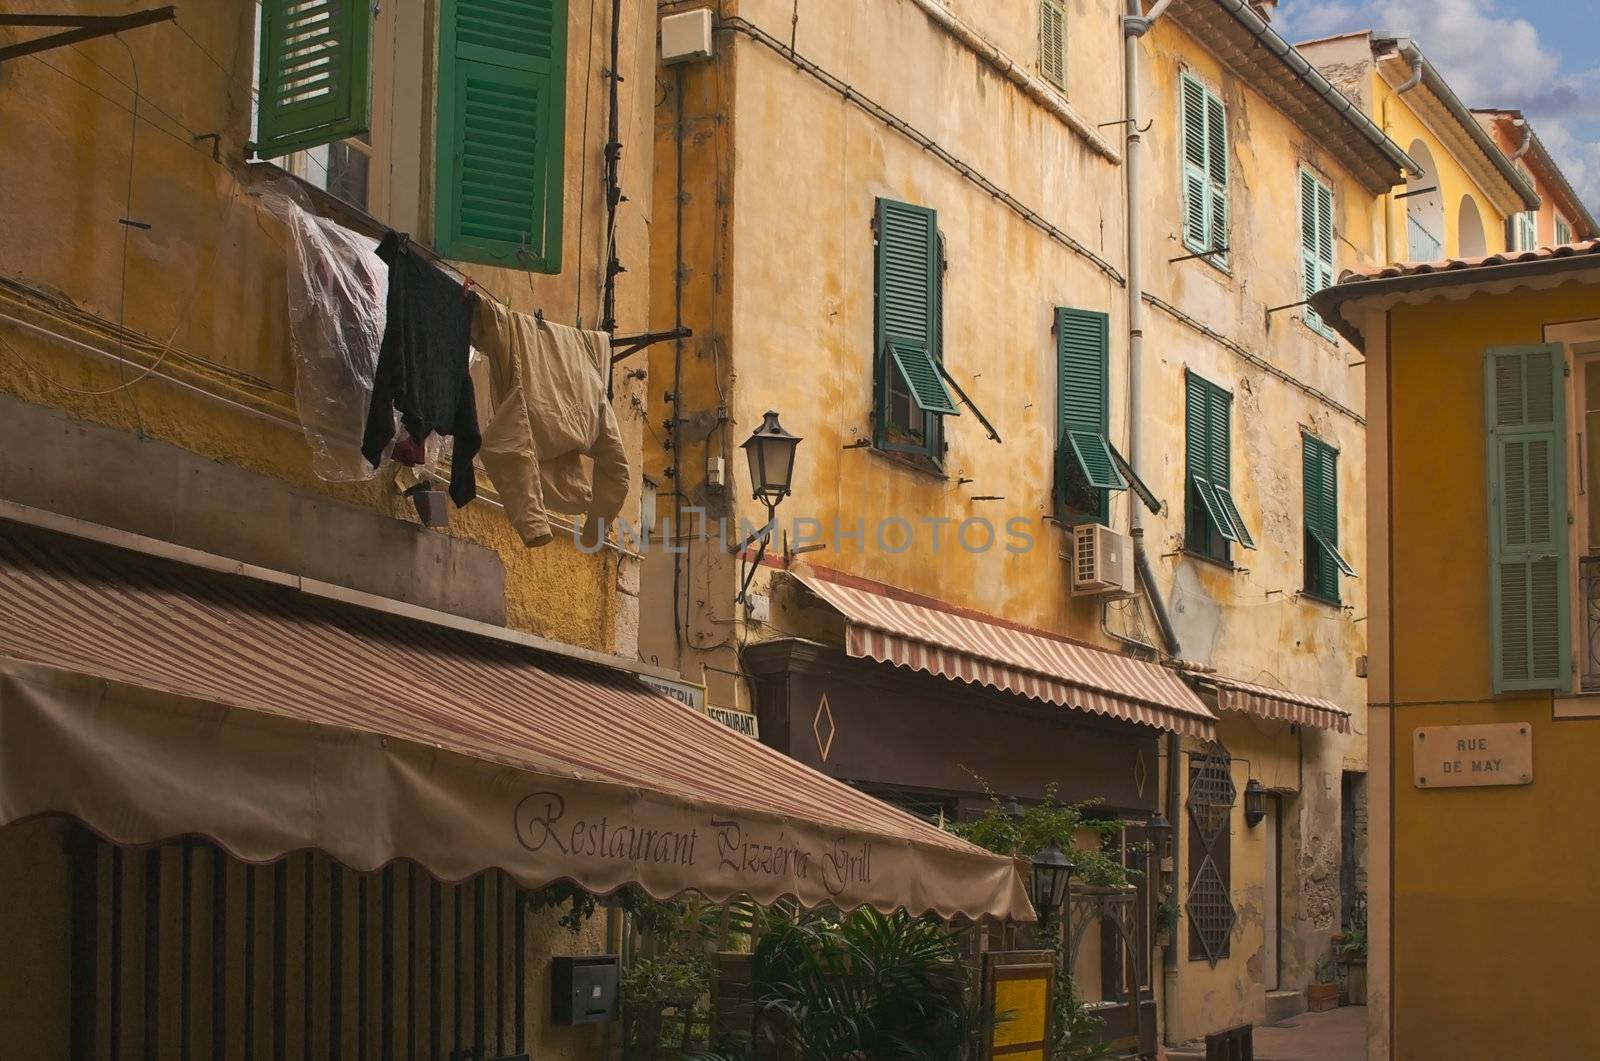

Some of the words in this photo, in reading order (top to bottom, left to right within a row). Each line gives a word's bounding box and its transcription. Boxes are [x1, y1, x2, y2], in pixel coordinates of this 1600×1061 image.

[647, 681, 694, 708] ZERIA
[1457, 738, 1487, 751] RUE
[1443, 761, 1462, 773] DE
[1471, 760, 1502, 772] MAY
[513, 791, 699, 867] Restaurant
[710, 815, 812, 879] Pizzéria
[821, 837, 873, 896] Grill
